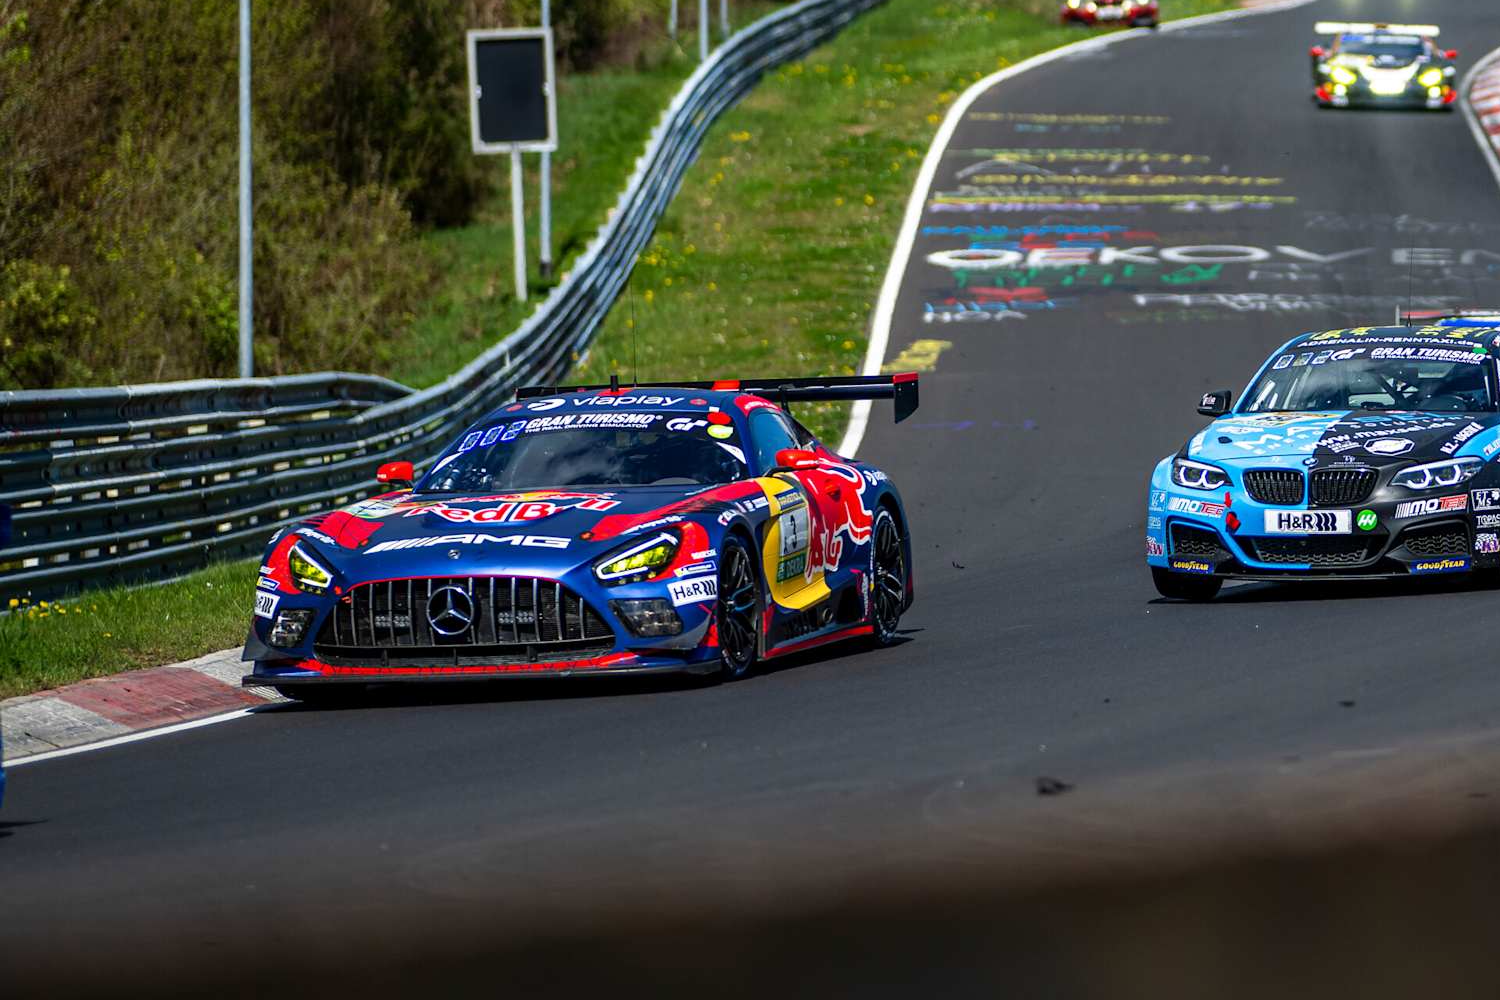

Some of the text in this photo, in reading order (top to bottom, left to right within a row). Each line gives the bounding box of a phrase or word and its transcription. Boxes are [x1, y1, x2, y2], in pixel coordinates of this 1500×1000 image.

[1371, 347, 1416, 357] GRAN
[573, 395, 685, 407] viaplay
[525, 414, 577, 430] GRAN
[1278, 512, 1314, 530] H&R
[424, 533, 572, 549] AMG
[1173, 560, 1209, 572] GOODYEAR
[1416, 559, 1466, 571] GOODYEAR
[674, 583, 703, 600] H&R
